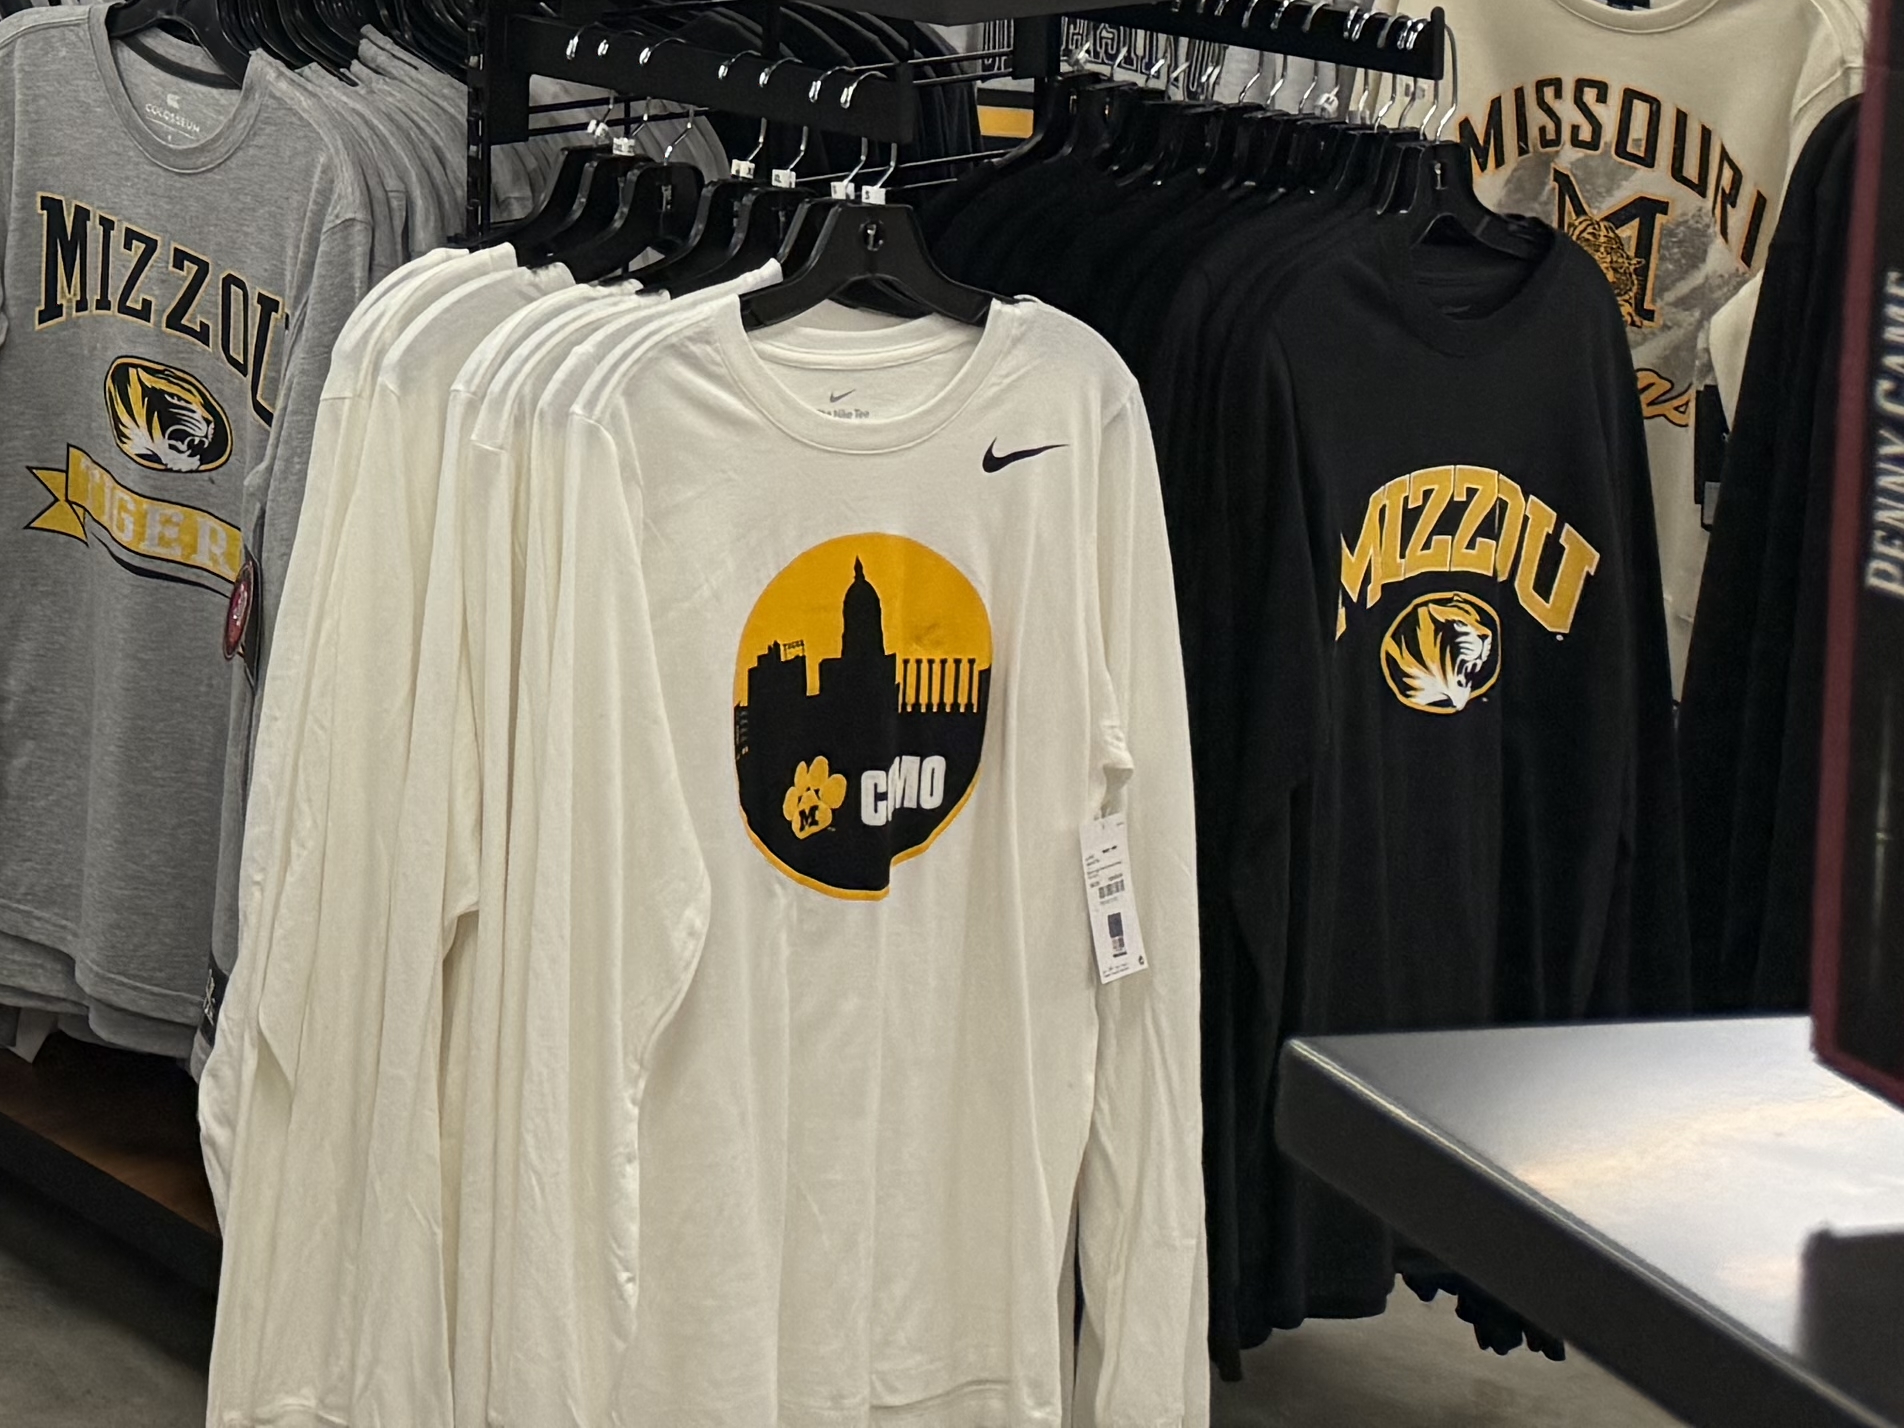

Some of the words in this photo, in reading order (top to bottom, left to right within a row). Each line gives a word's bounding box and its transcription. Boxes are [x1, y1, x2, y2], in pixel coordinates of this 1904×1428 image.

[145, 102, 201, 134] COLOSSEUM
[1457, 76, 1769, 272] MISSOURI
[854, 408, 870, 419] Tee
